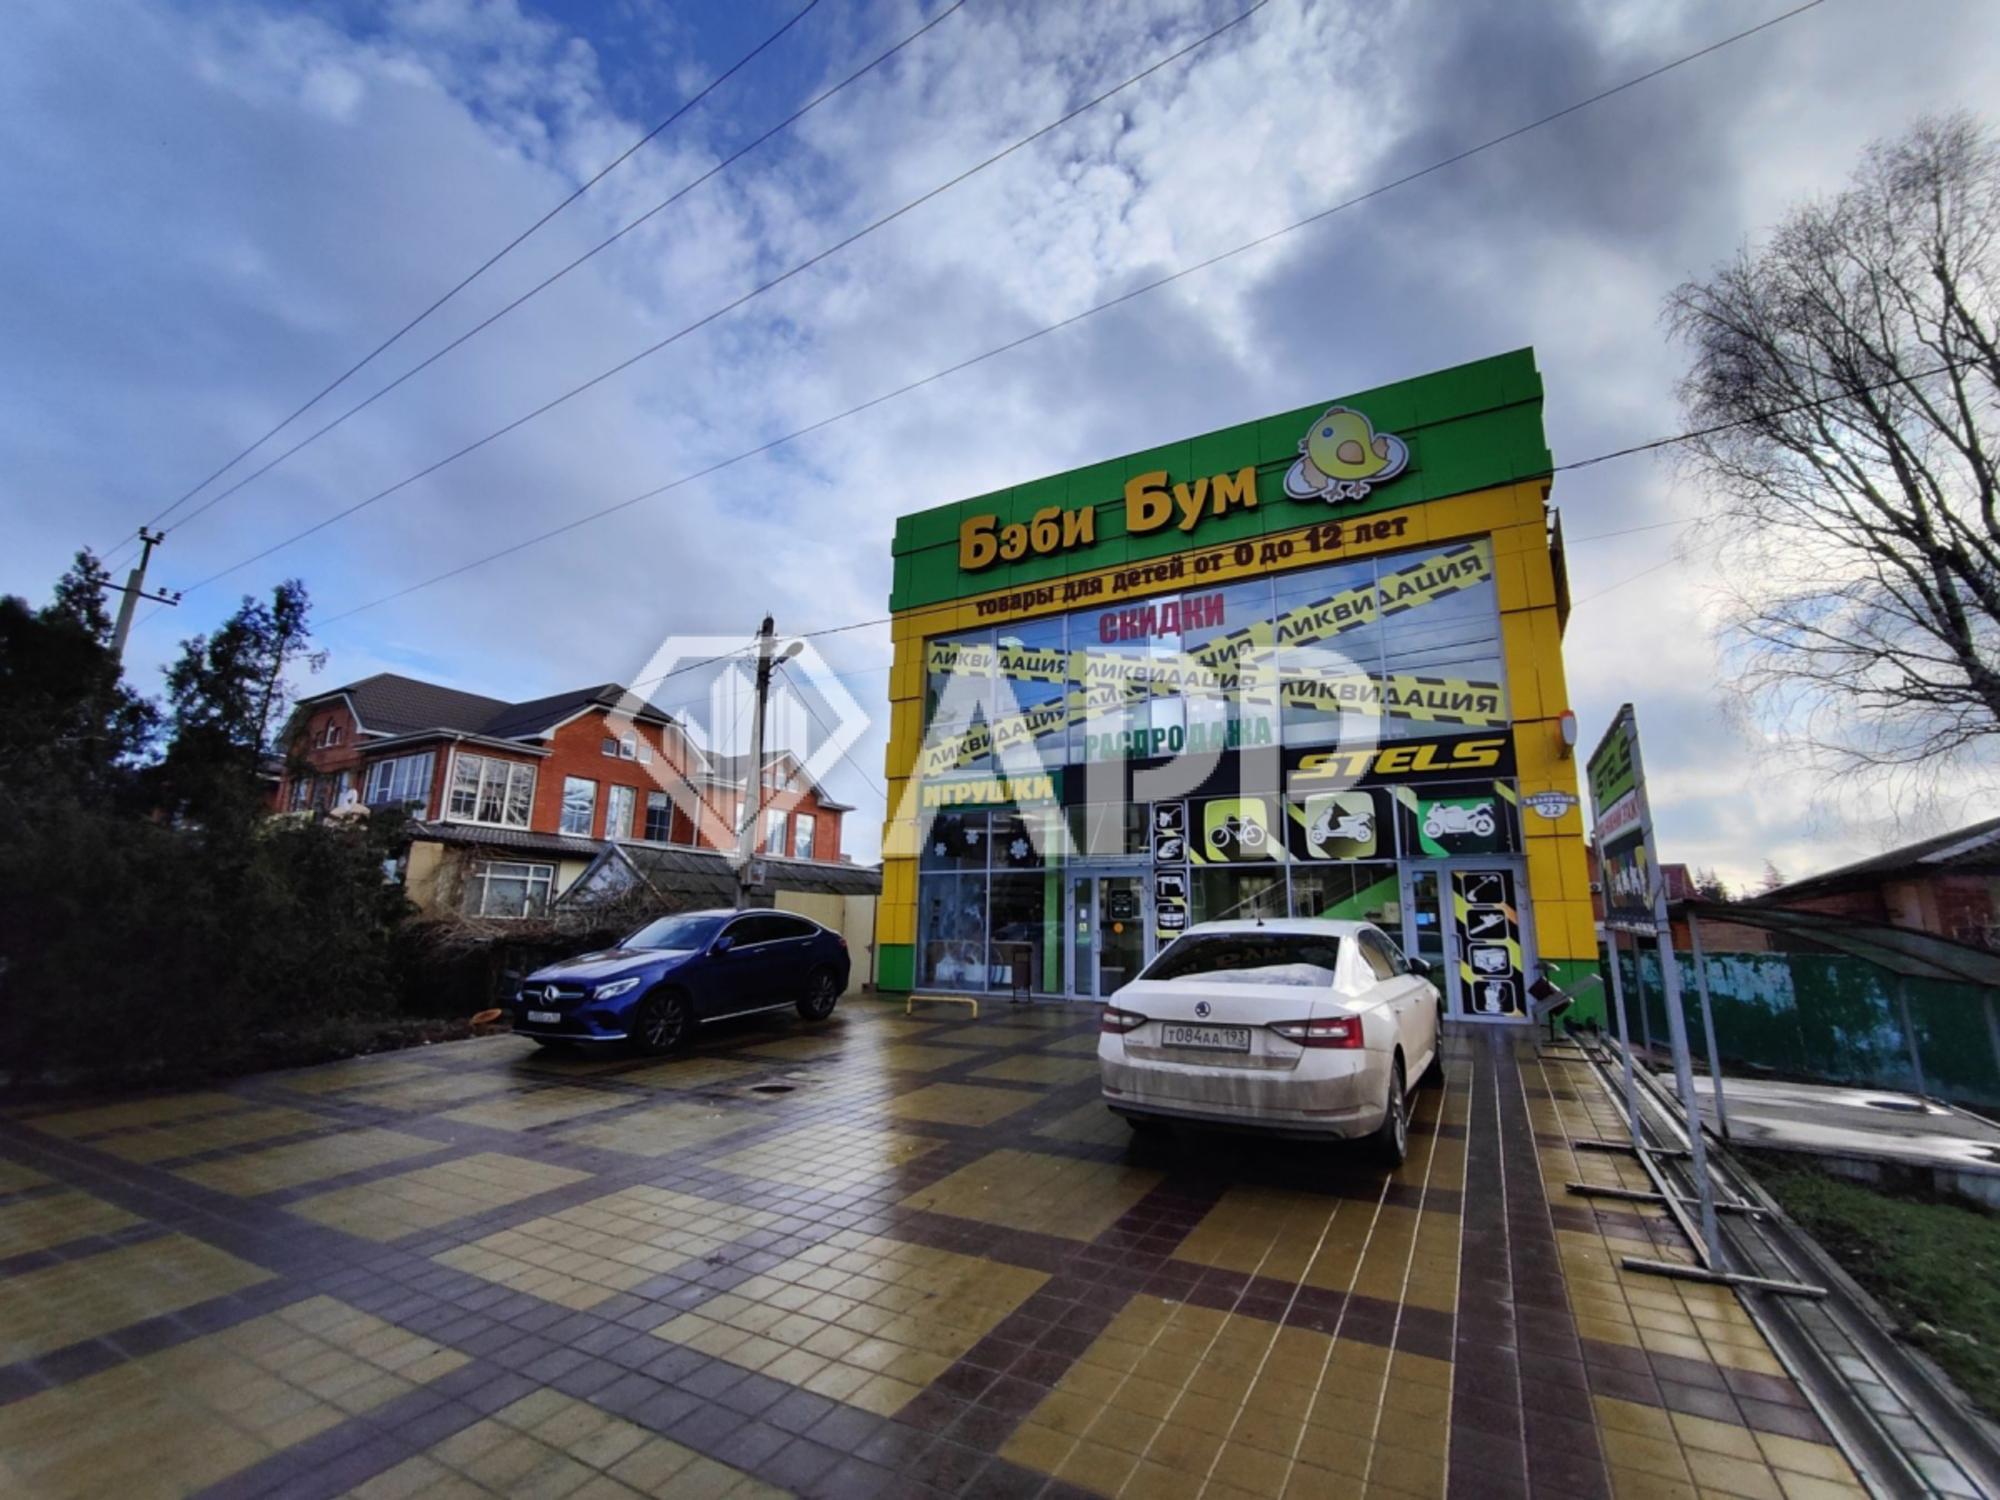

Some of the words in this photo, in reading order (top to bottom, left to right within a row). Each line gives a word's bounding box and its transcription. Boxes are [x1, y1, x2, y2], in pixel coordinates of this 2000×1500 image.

[958, 505, 1095, 571] Бэби
[1124, 466, 1259, 532] Бум
[976, 586, 1054, 617] товары
[1063, 577, 1104, 603] для
[1112, 556, 1185, 594] детей
[1193, 551, 1224, 574] от
[1260, 536, 1294, 564] до
[1304, 521, 1343, 552] 12
[1354, 515, 1410, 544] лет
[1100, 593, 1225, 644] СКИДКИ
[1276, 554, 1483, 643] ЛИКВИДАЦИЯ
[931, 650, 1066, 675] ЛИКВИДАЦИЯ
[1086, 662, 1257, 692] ЛИКВИДАЦИЯ
[1279, 681, 1498, 714] ЛИКВИДАЦИЯ
[929, 706, 1066, 767] ЛИКВИДАЦИЯ
[1086, 716, 1273, 760] РАСПРОДАЖА
[1291, 739, 1506, 780] STELS
[923, 775, 1054, 808] ИГРУШКИ
[1543, 804, 1561, 815] 22
[1223, 1030, 1246, 1043] 193
